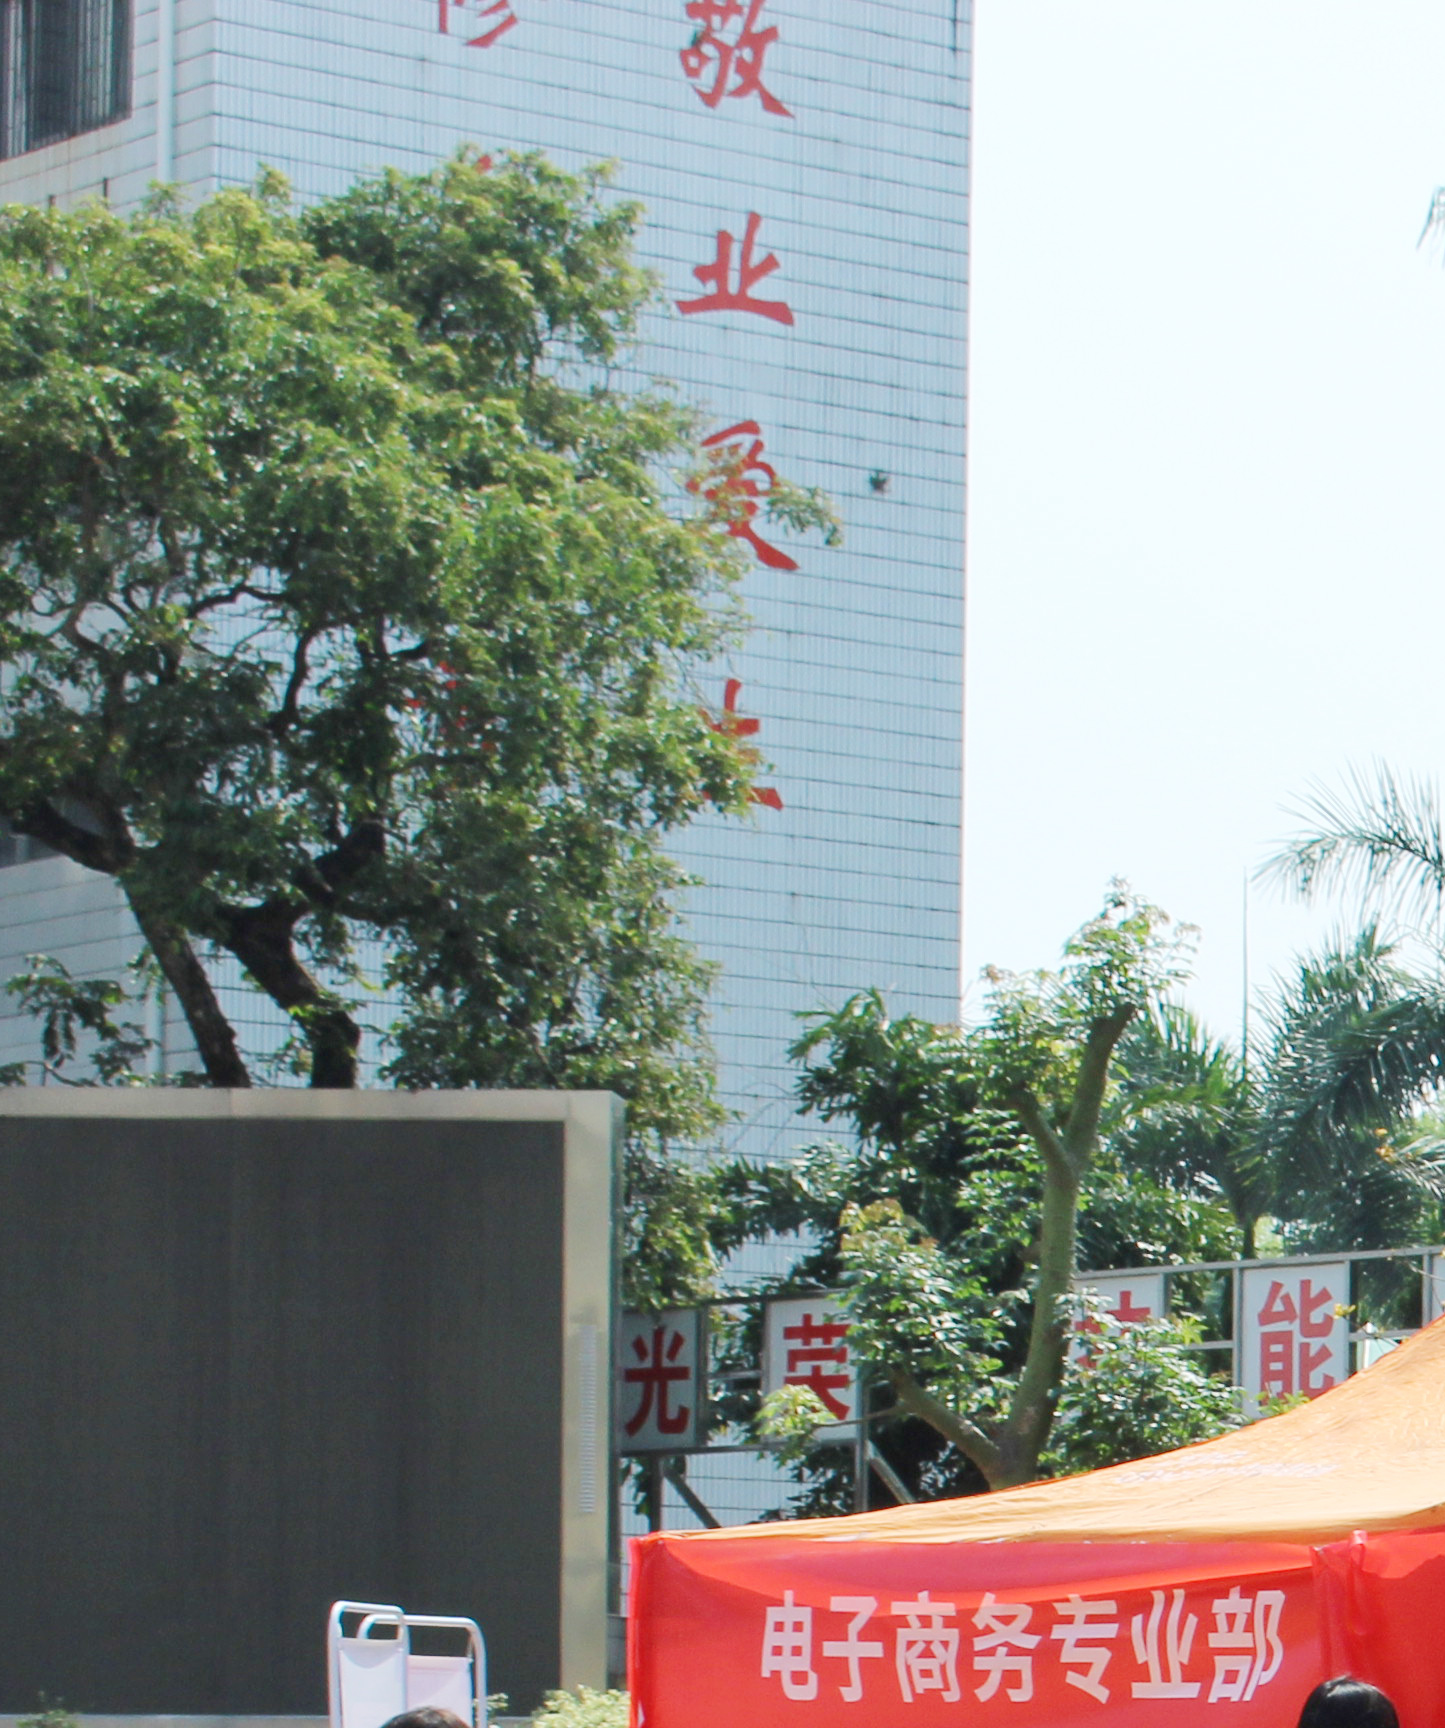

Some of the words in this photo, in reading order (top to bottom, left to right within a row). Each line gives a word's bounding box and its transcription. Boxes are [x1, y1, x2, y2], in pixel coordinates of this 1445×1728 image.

[760, 1587, 1285, 1705] 电子商务专业部
